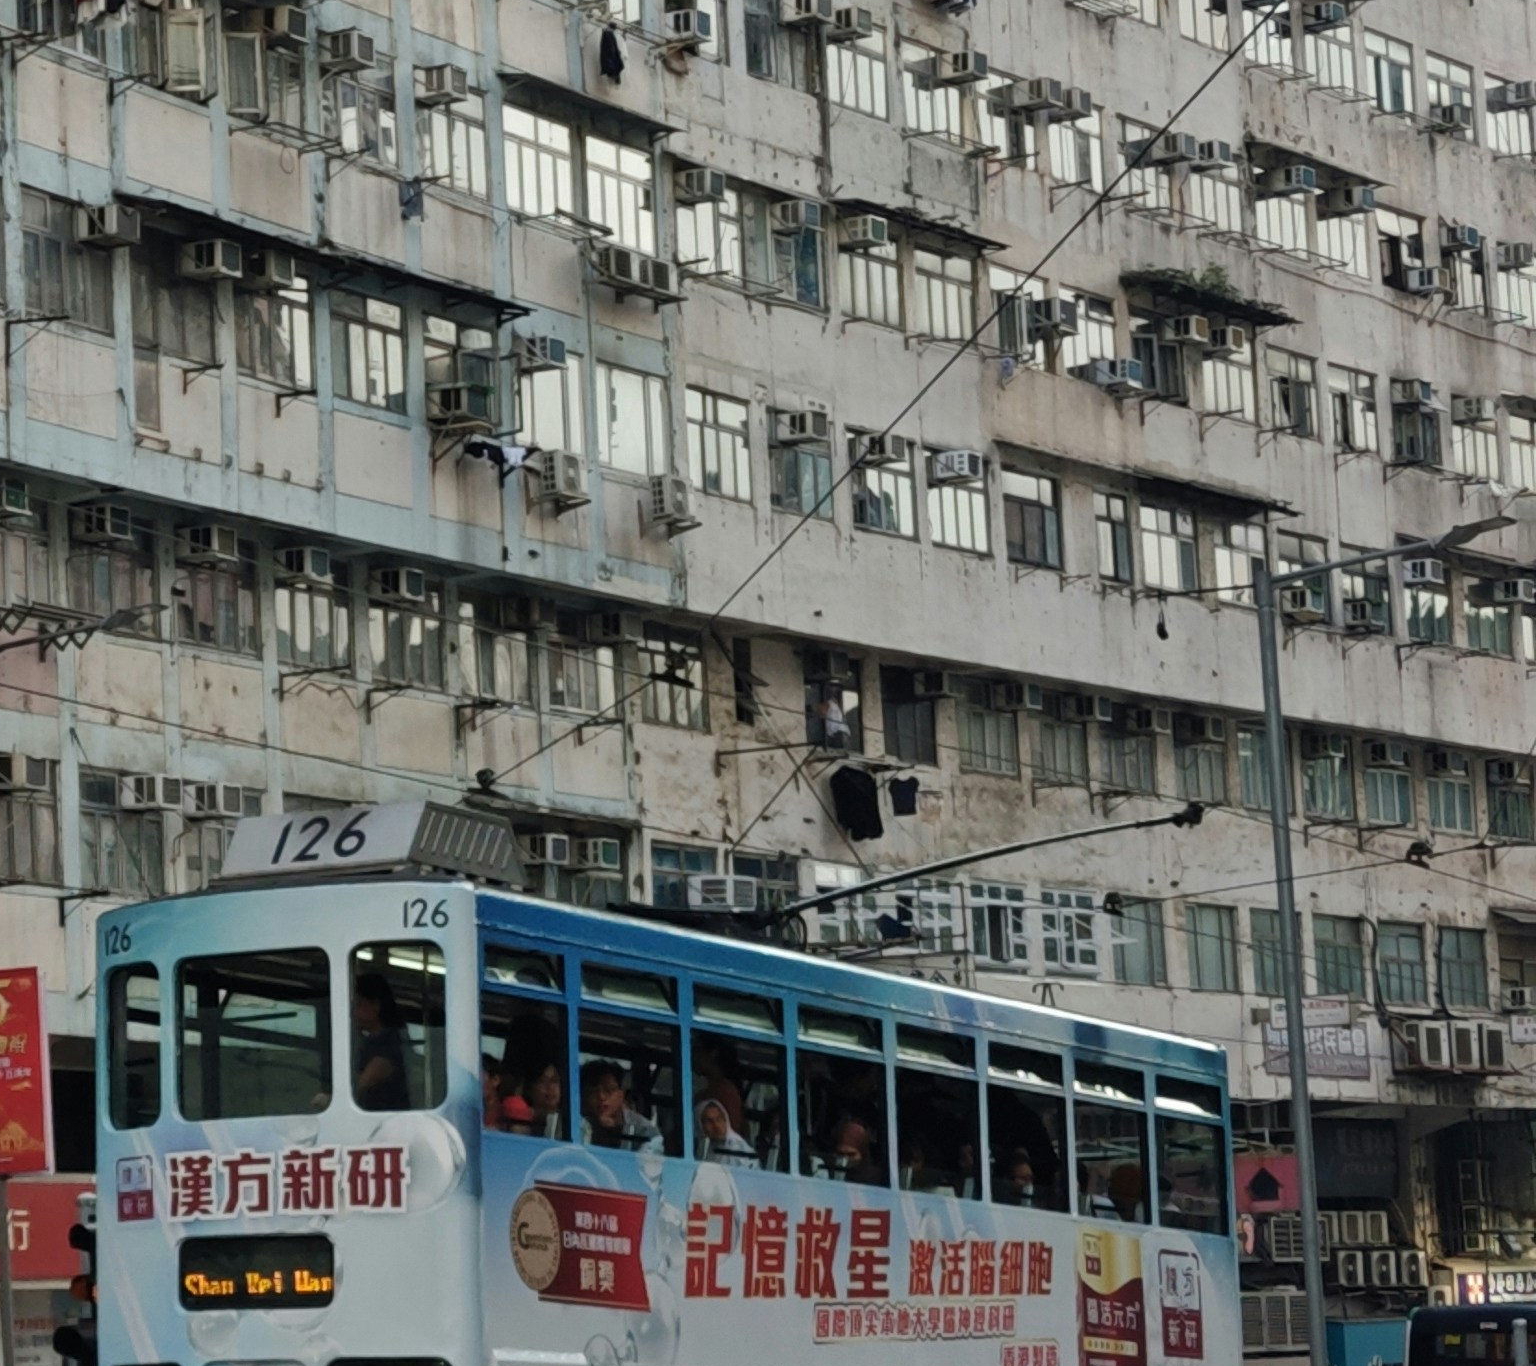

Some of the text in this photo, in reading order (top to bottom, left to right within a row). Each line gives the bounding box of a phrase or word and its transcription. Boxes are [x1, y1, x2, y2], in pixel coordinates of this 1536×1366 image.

[272, 812, 370, 864] 126
[403, 899, 449, 928] 126
[104, 927, 131, 955] 126
[170, 1146, 405, 1217] 漢方新研
[685, 1203, 1053, 1298] 記憶救星 激活腦細胞
